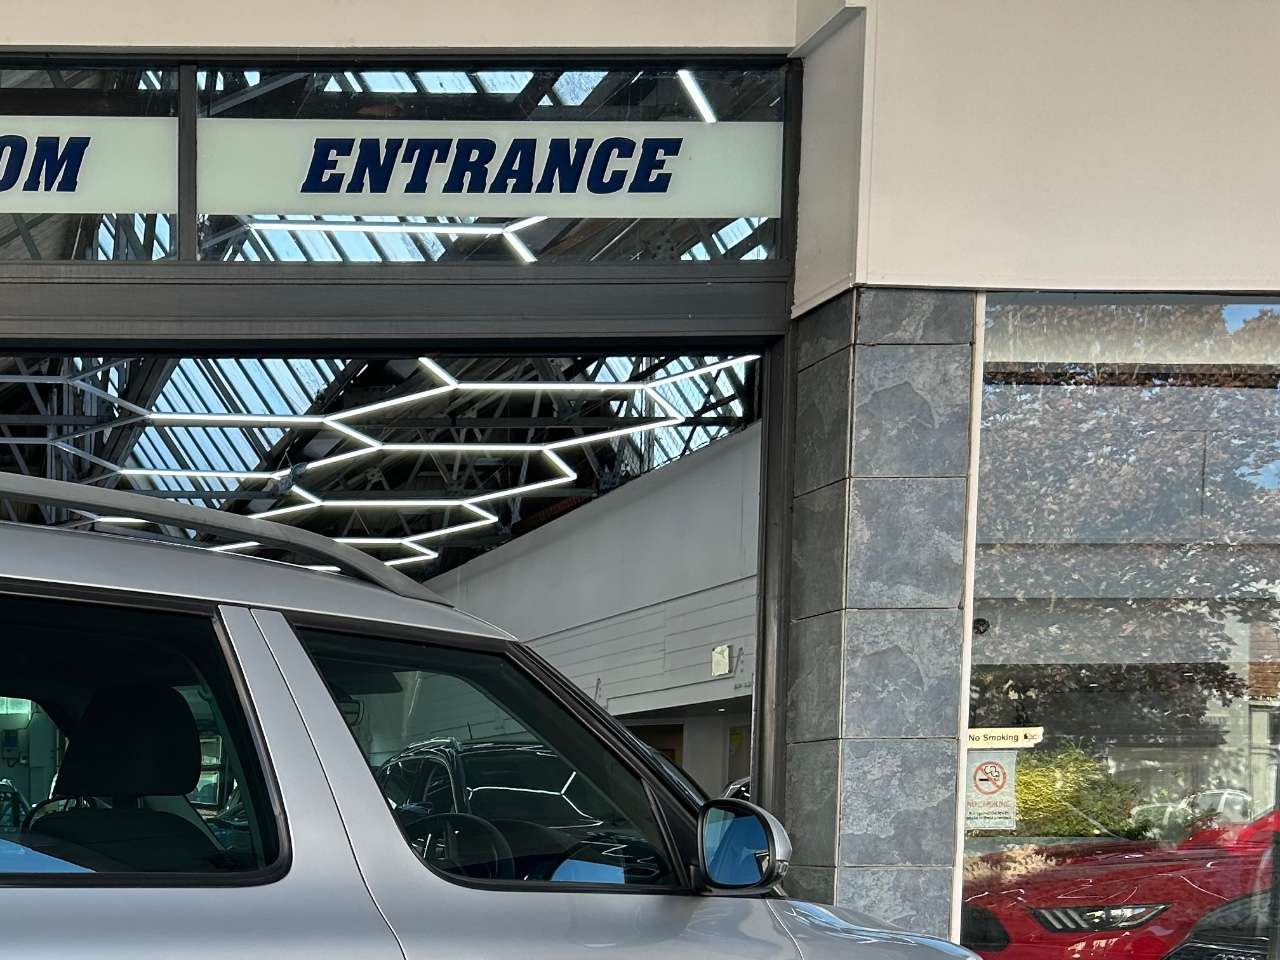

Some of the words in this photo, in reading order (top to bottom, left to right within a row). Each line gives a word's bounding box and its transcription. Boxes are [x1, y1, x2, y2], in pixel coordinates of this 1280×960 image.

[300, 137, 684, 195] ENTRANCE
[968, 734, 981, 742] No
[983, 733, 1019, 742] Smoking
